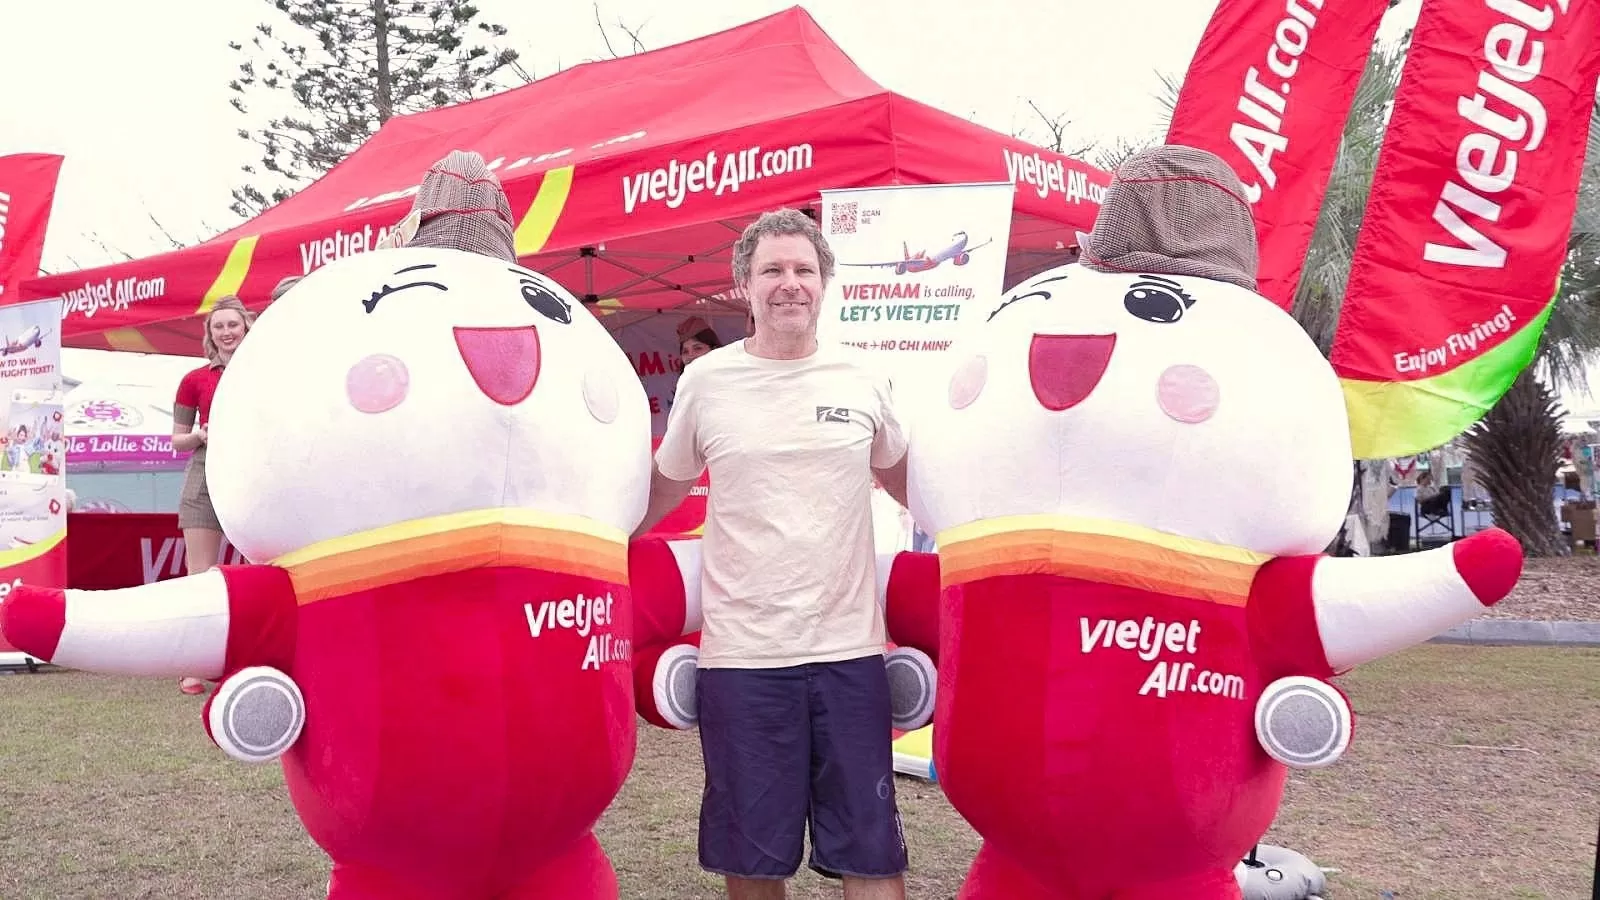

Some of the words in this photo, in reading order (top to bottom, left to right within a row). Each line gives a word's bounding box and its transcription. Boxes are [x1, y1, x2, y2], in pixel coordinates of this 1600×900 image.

[861, 209, 881, 217] SCAN
[842, 283, 920, 300] VIETNAM
[924, 285, 933, 298] is
[935, 285, 976, 300] calling,
[840, 306, 882, 322] LET'S
[886, 303, 960, 323] VIETJET!
[880, 340, 896, 350] HO
[899, 340, 920, 350] CHI
[1393, 346, 1447, 373] Enjoy
[1445, 304, 1517, 355] Flying!
[20, 357, 37, 366] WIN
[1, 368, 27, 378] FLIGHT
[89, 436, 137, 452] Lollie
